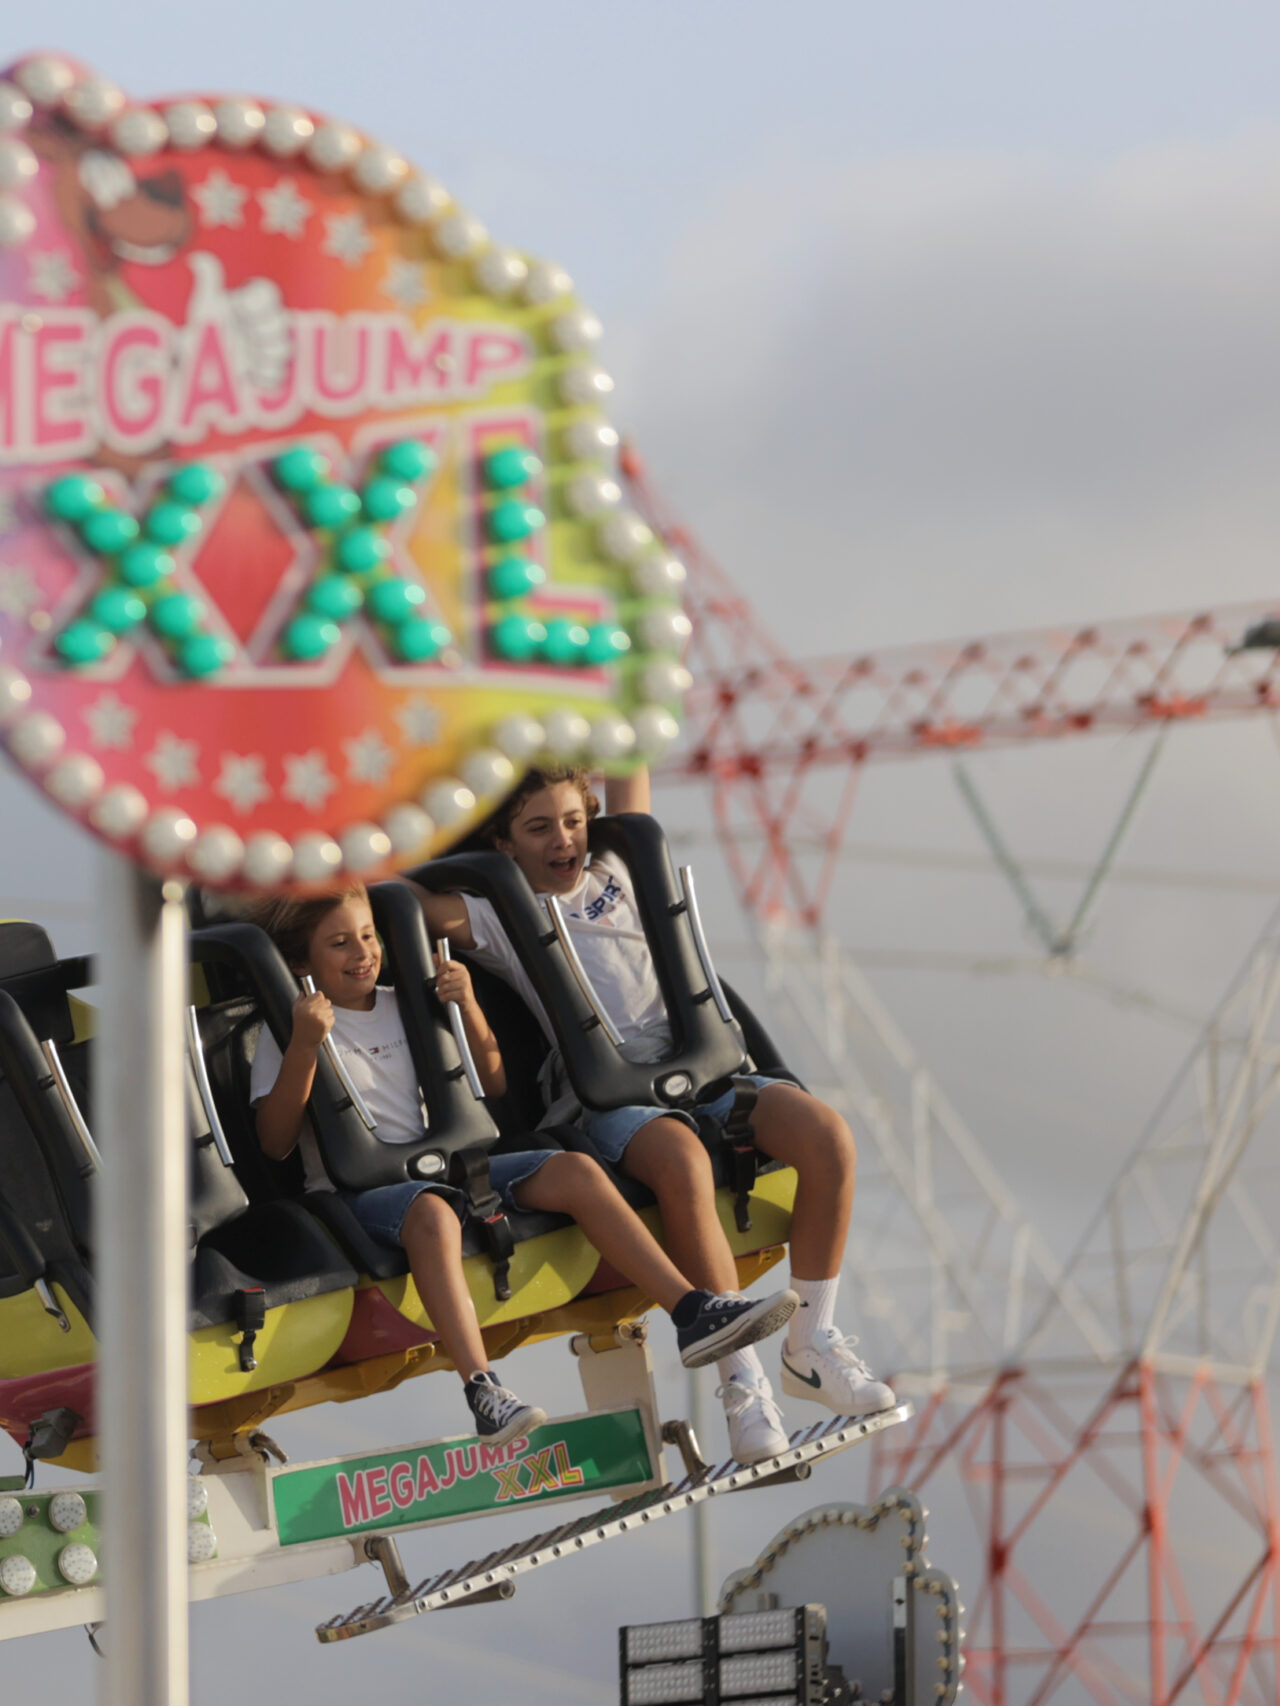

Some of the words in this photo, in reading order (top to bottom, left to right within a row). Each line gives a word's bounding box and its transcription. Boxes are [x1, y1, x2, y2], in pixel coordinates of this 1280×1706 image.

[25, 410, 618, 692] XXL
[337, 1437, 530, 1528] MEGAJUMP
[491, 1441, 583, 1501] XXL
